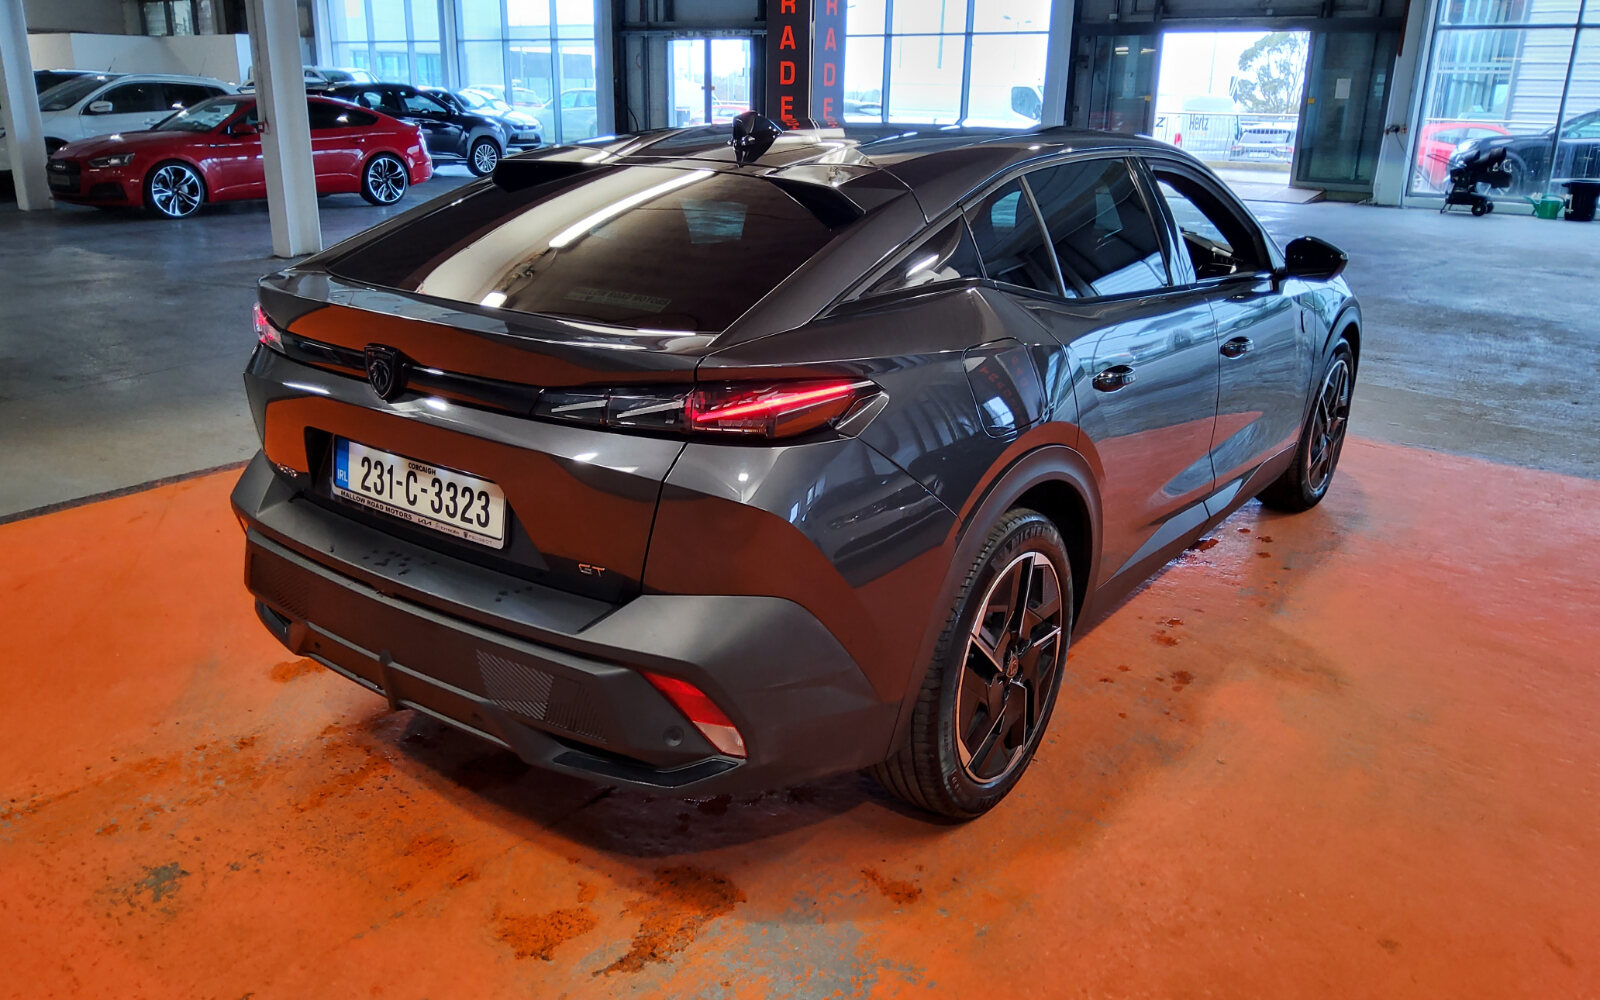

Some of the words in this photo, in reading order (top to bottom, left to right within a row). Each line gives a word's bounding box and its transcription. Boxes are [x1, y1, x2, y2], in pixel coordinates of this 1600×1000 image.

[337, 468, 348, 483] IRL
[408, 462, 437, 476] CORCAIGH
[361, 456, 491, 529] 231-C-3323
[341, 491, 366, 504] MALLOW
[366, 500, 384, 511] ROAD
[385, 506, 413, 521] MOTORS
[578, 563, 605, 577] GT
